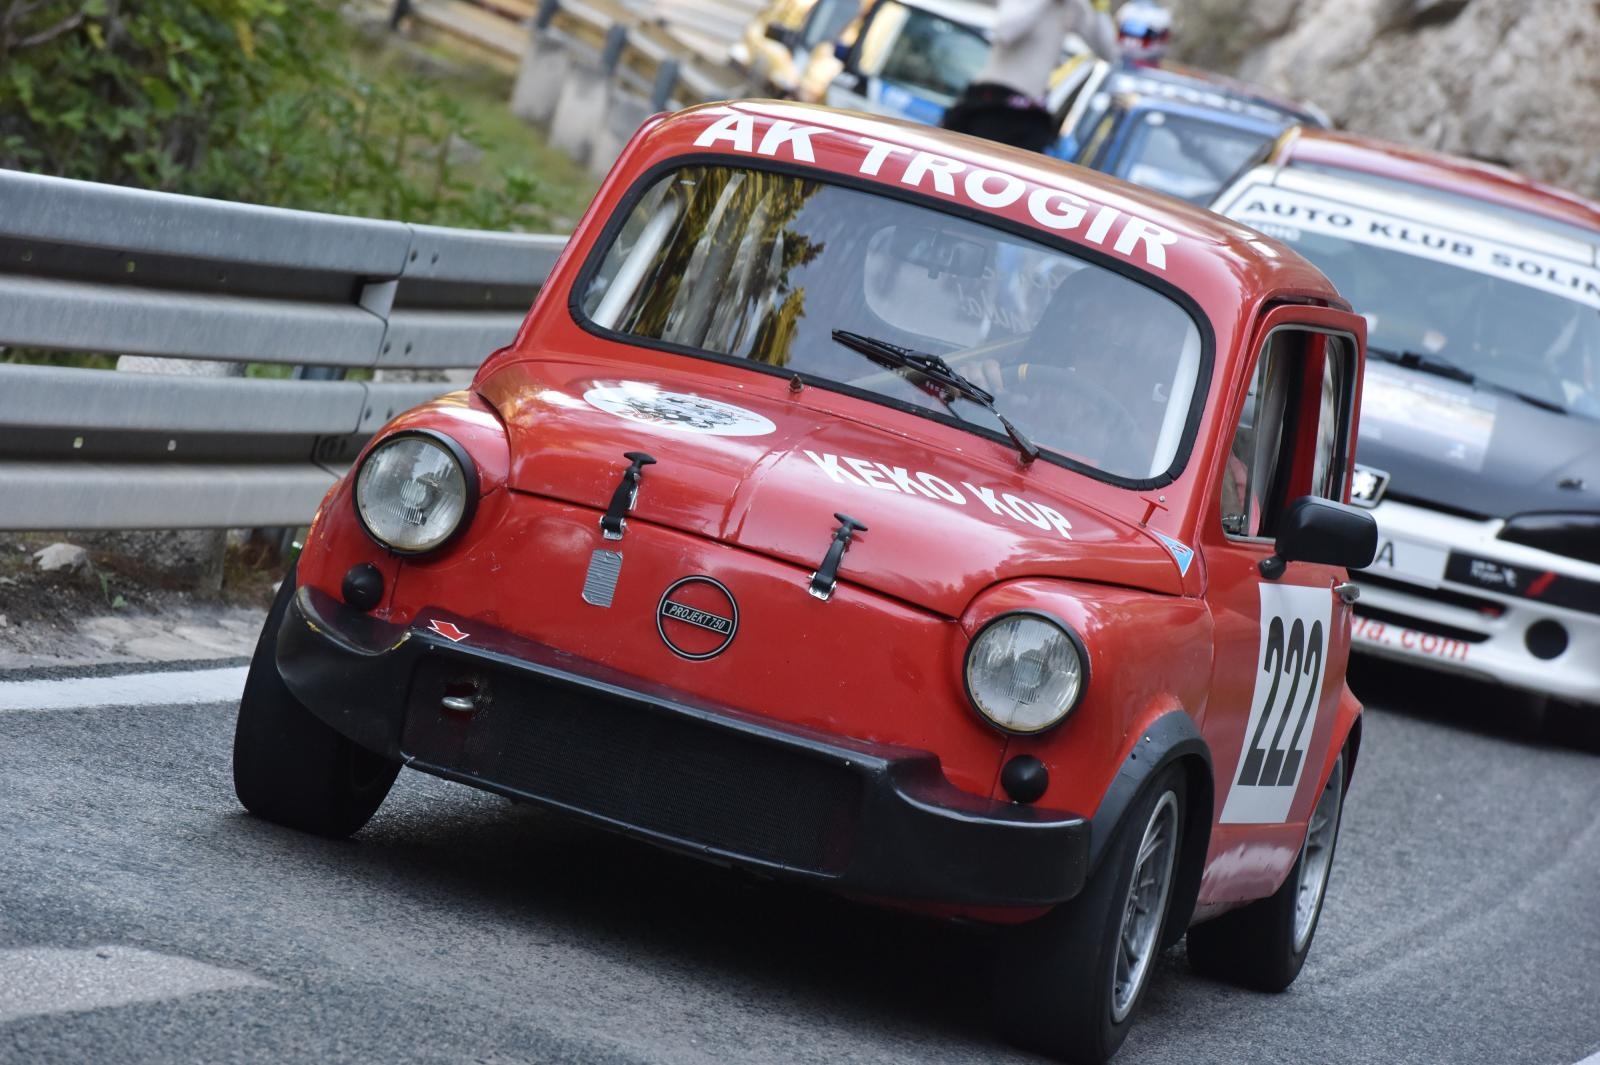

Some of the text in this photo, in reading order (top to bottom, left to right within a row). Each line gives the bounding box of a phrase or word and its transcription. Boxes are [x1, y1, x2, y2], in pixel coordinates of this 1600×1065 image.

[693, 114, 1179, 271] AK TROGIR
[1246, 201, 1353, 228] AUTO
[1368, 222, 1474, 257] KLUB
[803, 450, 1073, 541] KEKO KOP
[668, 604, 726, 630] PROJEKT 750
[1236, 615, 1323, 787] 222
